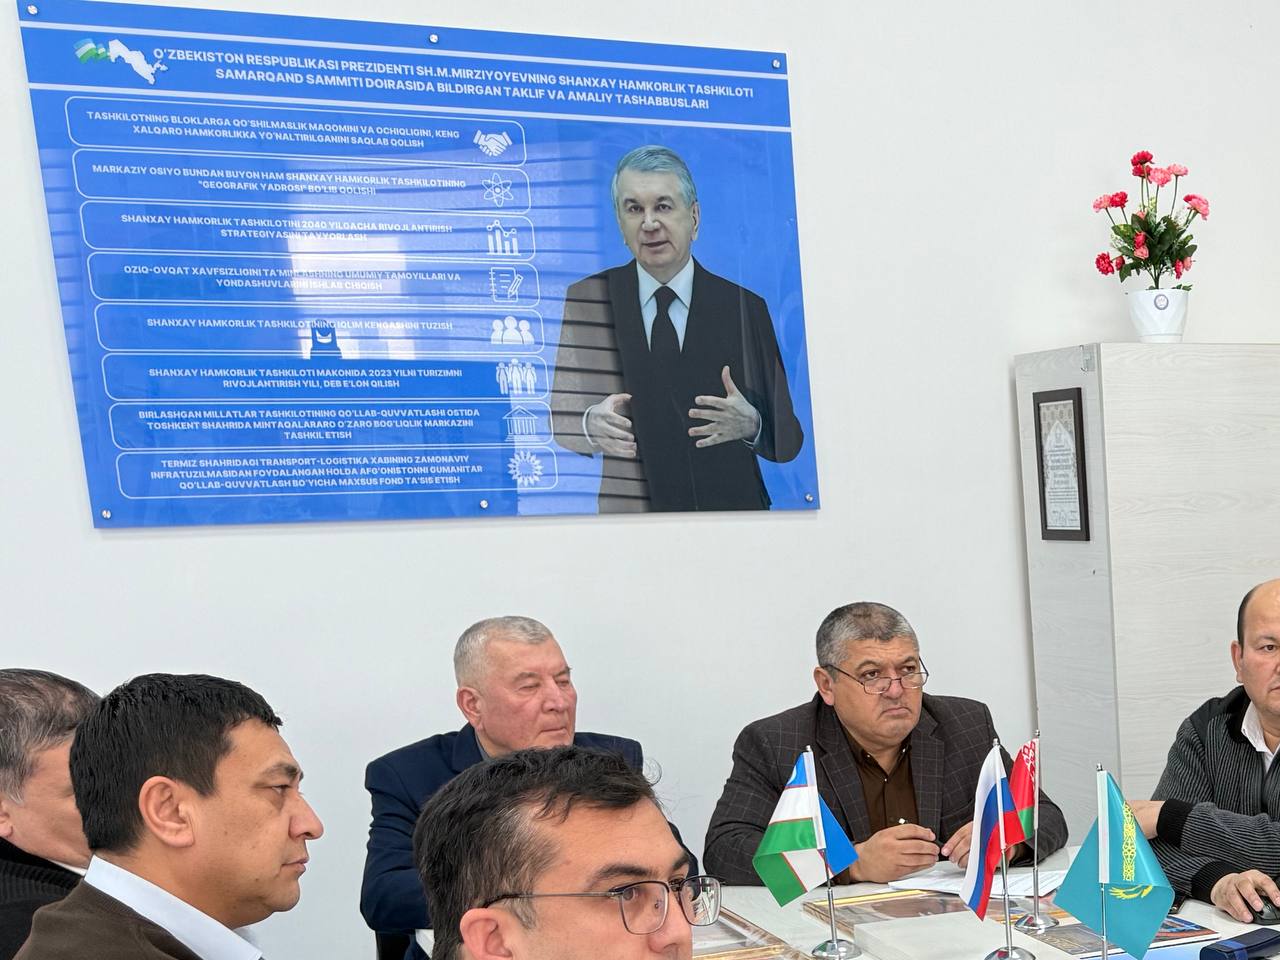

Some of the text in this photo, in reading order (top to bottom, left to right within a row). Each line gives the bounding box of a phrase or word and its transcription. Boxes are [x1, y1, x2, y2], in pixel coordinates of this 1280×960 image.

[153, 48, 754, 97] O'ZBEKISTON RESPUBLIKASI PREZIDENTI SH.M.MIRZIYOYEVNING SHANXAY HAMKORLIK TASHKILOTI
[215, 69, 709, 109] SAMARQAND SAMMITI DOIRASIDA BILDIRGAN TAKLIF VA AMALIY TASHABBUSLARI
[86, 111, 460, 139] TASHKILOTNING BLOKLARGA QO'SHILMASLIK MAQOMINI VA OCHIQLIGINI, KENG
[133, 126, 183, 137] XALQARO
[184, 128, 257, 140] HAMKORLIKKA
[351, 136, 389, 146] SAQLAB
[390, 138, 424, 147] QOLISH
[92, 165, 466, 188] MARKAZIY OSIYO BUNDAN BUYON HAM SHANXAY HAMKORLIK TASHKILOTINING
[120, 215, 171, 224] SHANXAY
[173, 216, 232, 226] HAMKORLIK
[234, 218, 300, 228] TASHKILOTINI
[302, 220, 327, 229] 2040
[123, 266, 189, 275] OZIQ-OVQAT
[192, 268, 262, 277] XAVFSIZLIGINI
[384, 272, 446, 280] TAMOYILLARI
[146, 319, 196, 327] SHANXAY
[198, 319, 256, 328] HAMKORLIK
[420, 322, 453, 330] TUZISH
[149, 369, 198, 377] SHANXAY
[200, 369, 257, 377] HAMKORLIK
[223, 380, 300, 388] RIVOJLANTIRISH
[302, 380, 322, 388] YILI,
[323, 380, 342, 388] DEB
[343, 380, 369, 388] E'LON
[203, 410, 257, 418] MILLATLAR
[201, 421, 252, 429] SHAHRIDA
[198, 459, 258, 467] SHAHRIDAGI
[259, 457, 368, 466] TRANSPORT-LOGISTIKA
[150, 470, 252, 479] INFRATUZILMASIDAN
[253, 468, 326, 477] FOYDALANGAN
[326, 468, 358, 476] HOLDA
[430, 465, 483, 473] GUMANITAR
[293, 479, 337, 487] BO'YICHA
[338, 478, 378, 486] MAXSUS
[379, 477, 404, 485] FOND
[434, 476, 460, 484] ETISH
